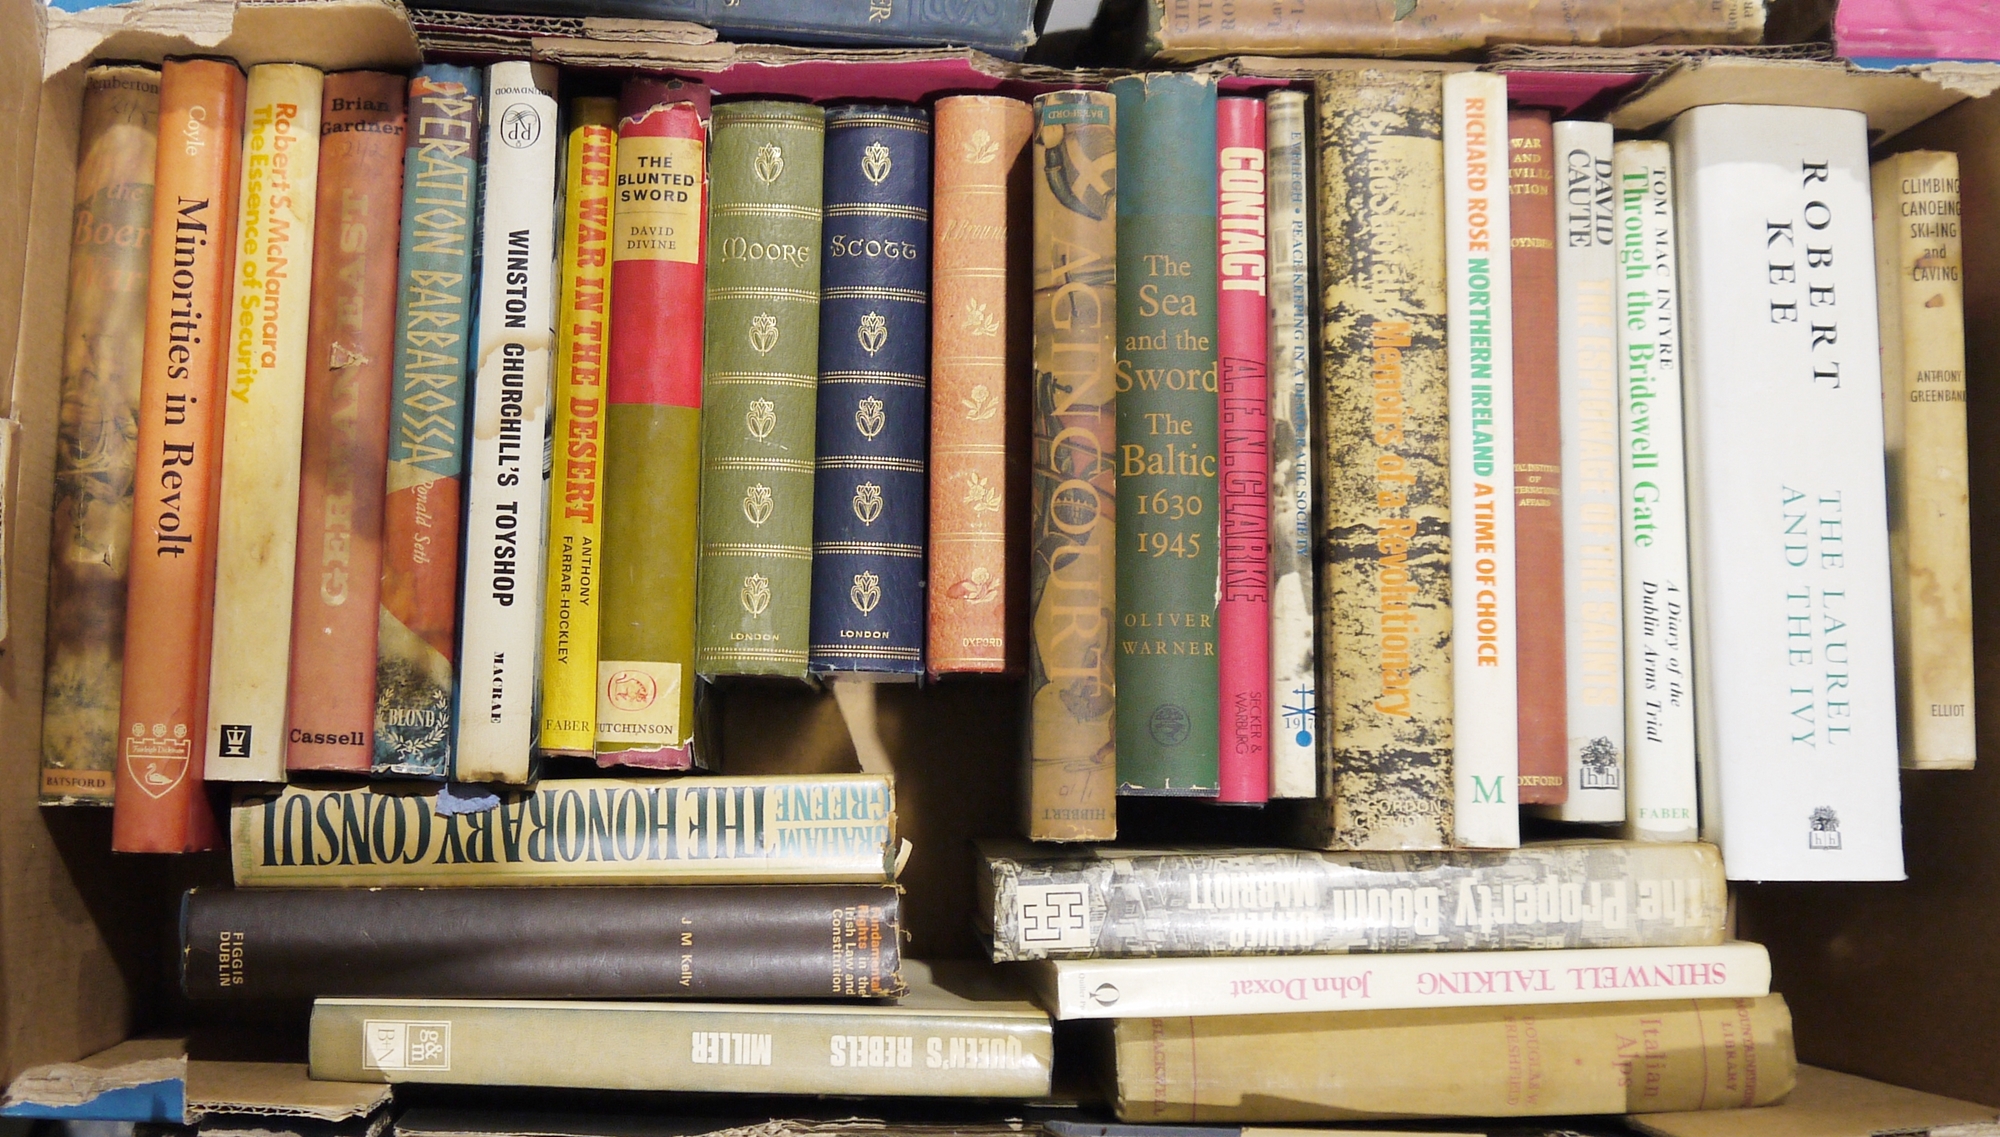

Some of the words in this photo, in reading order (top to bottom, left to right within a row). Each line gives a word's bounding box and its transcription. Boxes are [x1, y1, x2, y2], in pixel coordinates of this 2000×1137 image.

[251, 103, 274, 151] The
[332, 97, 390, 113] Brian
[1048, 109, 1105, 121] BATSFORD
[186, 105, 206, 156] Coyle
[271, 103, 298, 192] Robert
[321, 120, 403, 137] Gardner
[1465, 98, 1488, 192] RICHARD
[1510, 137, 1542, 149] WAR
[581, 125, 612, 187] THE
[637, 156, 672, 169] THE
[1513, 153, 1542, 163] AND
[617, 173, 696, 188] BLUNTED
[621, 189, 689, 203] SWORD
[1567, 149, 1592, 248] CAUTE
[1595, 156, 1614, 246] DAVID
[1653, 166, 1668, 216] TOM
[1902, 178, 1960, 194] CLIMBING
[243, 153, 270, 256] Essence
[1220, 147, 1266, 297] CONTACT
[1467, 197, 1489, 252] ROSE
[1620, 166, 1652, 280] Through
[1901, 201, 1961, 217] CANOEING
[576, 197, 609, 269] WAR
[627, 239, 677, 251] DIVINE
[630, 225, 675, 237] DAVID
[1655, 228, 1670, 277] MAC
[1911, 222, 1957, 239] SKI-ING
[1924, 244, 1946, 259] and
[242, 263, 263, 289] of
[336, 187, 369, 332] EAST
[505, 229, 530, 329] WINSTON
[1144, 254, 1192, 278] The
[1292, 220, 1305, 341] PEACE-KEEPING
[1766, 217, 1798, 325] KEE
[1802, 157, 1841, 390] ROBERT
[1912, 266, 1958, 281] CAVING
[165, 196, 209, 380] Minorities
[574, 276, 604, 313] IN
[1138, 284, 1199, 318] Sea
[1577, 279, 1611, 328] THE
[1468, 257, 1493, 379] NORTHERN
[1627, 290, 1654, 332] the
[1657, 288, 1673, 370] INTYRE
[230, 291, 260, 404] Security
[570, 319, 603, 387] THE
[1125, 329, 1168, 352] and
[1175, 329, 1210, 352] the
[1294, 345, 1306, 362] IN
[400, 270, 463, 476] BARBAROSSA
[1114, 358, 1219, 393] Sword
[1294, 367, 1305, 378] A
[1371, 322, 1413, 446] Memoirs
[1917, 370, 1962, 383] ANTHONY
[164, 393, 198, 425] in
[497, 342, 525, 487] CHURCHILL'S
[1144, 412, 1194, 436] The
[1628, 342, 1659, 469] Bridewell
[1471, 384, 1496, 477] IRELAND
[565, 397, 599, 524] DESERT
[1049, 240, 1102, 698] AGINCOURT
[1120, 444, 1217, 478] Baltic
[1375, 453, 1415, 484] of
[157, 441, 194, 558] Revolt
[411, 481, 435, 528] Ronald
[1137, 489, 1203, 517] 1630
[1376, 488, 1415, 508] a
[1474, 482, 1495, 498] A
[1296, 490, 1309, 557] SOCIETY
[1474, 500, 1497, 554] TIME
[1580, 502, 1617, 539] OF
[1632, 480, 1660, 548] Gate
[1782, 483, 1809, 569] AND
[1819, 489, 1846, 571] THE
[412, 533, 431, 565] Seth
[492, 501, 518, 607] TOYSHOP
[1137, 530, 1202, 560] 1945
[1224, 470, 1267, 603] CLARKE
[581, 536, 593, 606] ANTHONY
[1475, 558, 1497, 587] OF
[1580, 542, 1617, 593] THE
[1667, 580, 1681, 592] A
[558, 536, 573, 664] FARRAR-HOCKLEY
[1124, 613, 1213, 629] OLIVER
[1375, 518, 1417, 718] Revolutionary
[1642, 580, 1659, 637] Dublin
[729, 632, 780, 642] LONDON
[839, 629, 890, 640] LONDON
[962, 637, 1004, 648] OXFORD
[1475, 589, 1499, 668] CHOICE
[1665, 598, 1683, 652] Diary
[1786, 585, 1813, 667] THE
[1122, 640, 1216, 657] WARNER
[1581, 600, 1618, 707] SAINTS
[1643, 643, 1661, 690] Arms
[1667, 657, 1684, 679] of
[1822, 589, 1851, 746] LAUREL
[1249, 691, 1263, 739] SECKER
[1671, 683, 1684, 707] the
[1931, 704, 1965, 718] ELLIOT
[290, 729, 366, 747] Cassell
[388, 708, 436, 729] BLOND
[545, 719, 590, 733] FABER
[1235, 692, 1250, 756] WARBURG
[1646, 701, 1663, 743] Trial
[1789, 686, 1816, 750] IVY
[1250, 743, 1263, 754] &
[46, 775, 106, 790] BATSFORD
[774, 784, 890, 821] GREENE
[1471, 775, 1506, 804] M
[436, 786, 682, 865] HONORARY
[686, 784, 775, 861] THE
[1042, 808, 1106, 820] HIBBERT
[1366, 799, 1441, 814] GORDON
[1639, 807, 1690, 819] FABER
[260, 791, 432, 867] CONSUL
[1188, 871, 1316, 911] MARRIOTT
[1333, 886, 1441, 936] Boom
[1454, 876, 1628, 934] Property
[1637, 878, 1703, 929] The
[681, 917, 691, 926] J
[681, 932, 692, 947] M
[845, 906, 857, 938] Irish
[219, 931, 231, 988] DUBLIN
[233, 931, 244, 986] FIGGIS
[679, 954, 692, 988] Kelly
[832, 908, 844, 993] Constitution
[845, 942, 857, 970] Law
[858, 956, 870, 969] in
[870, 906, 883, 993] Fundamental
[845, 973, 856, 995] and
[1230, 976, 1307, 1001] Doxat
[1313, 970, 1373, 1000] John
[1416, 968, 1556, 997] TALKING
[1566, 961, 1727, 991] SHINWELL
[692, 1031, 773, 1067] MILLER
[830, 1033, 914, 1069] REBELS
[926, 1034, 1023, 1071] QUEEN'S
[1151, 1018, 1170, 1116] BLACKWELL
[1504, 1015, 1522, 1107] FRESHFIELD
[1523, 1016, 1542, 1090] DOUGLAS
[1612, 1033, 1637, 1088] Alps
[1640, 1018, 1667, 1099] Italian
[1721, 1021, 1738, 1092] LIBRARY
